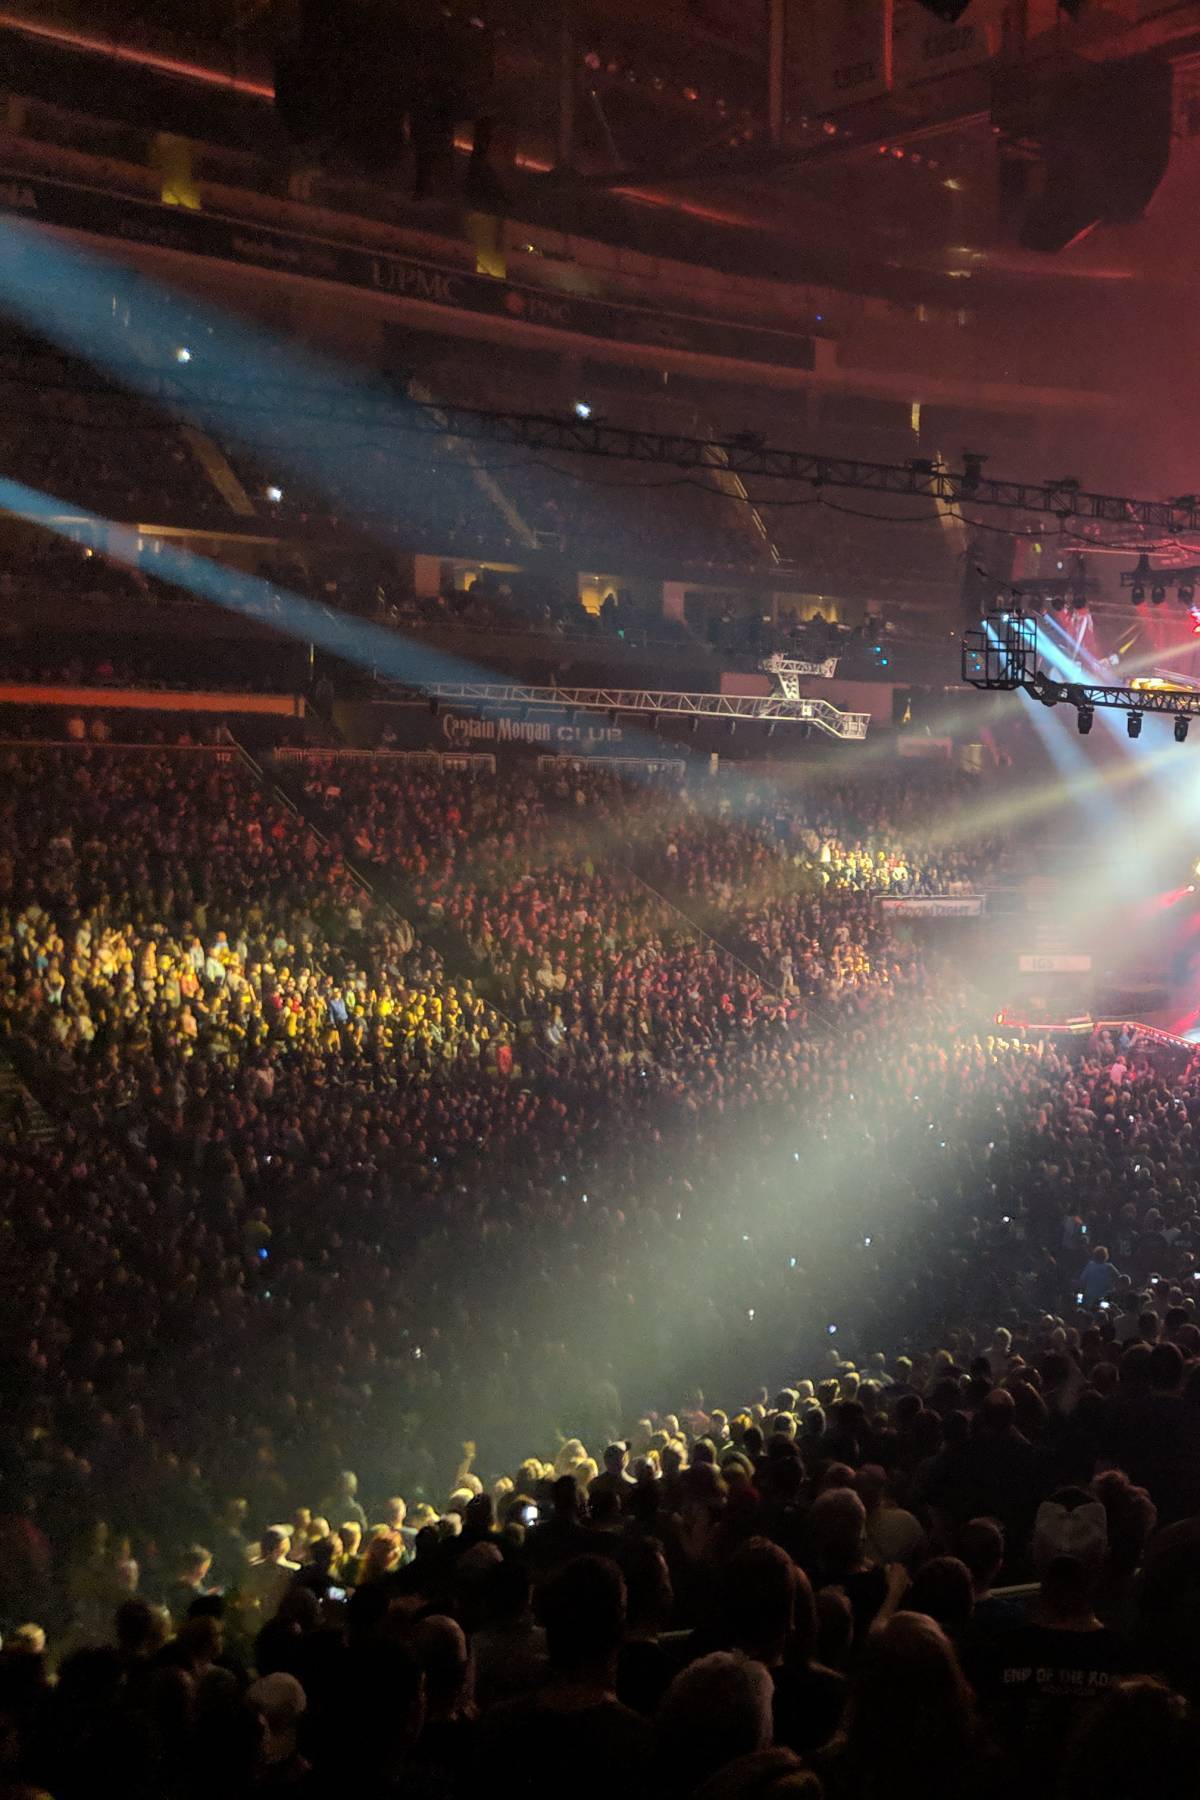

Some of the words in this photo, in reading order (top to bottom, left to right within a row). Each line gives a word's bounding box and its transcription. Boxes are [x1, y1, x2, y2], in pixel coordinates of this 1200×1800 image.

[371, 259, 458, 302] UPMC
[443, 713, 494, 739] Captain
[497, 717, 550, 744] Morgan
[557, 725, 623, 743] CLUB
